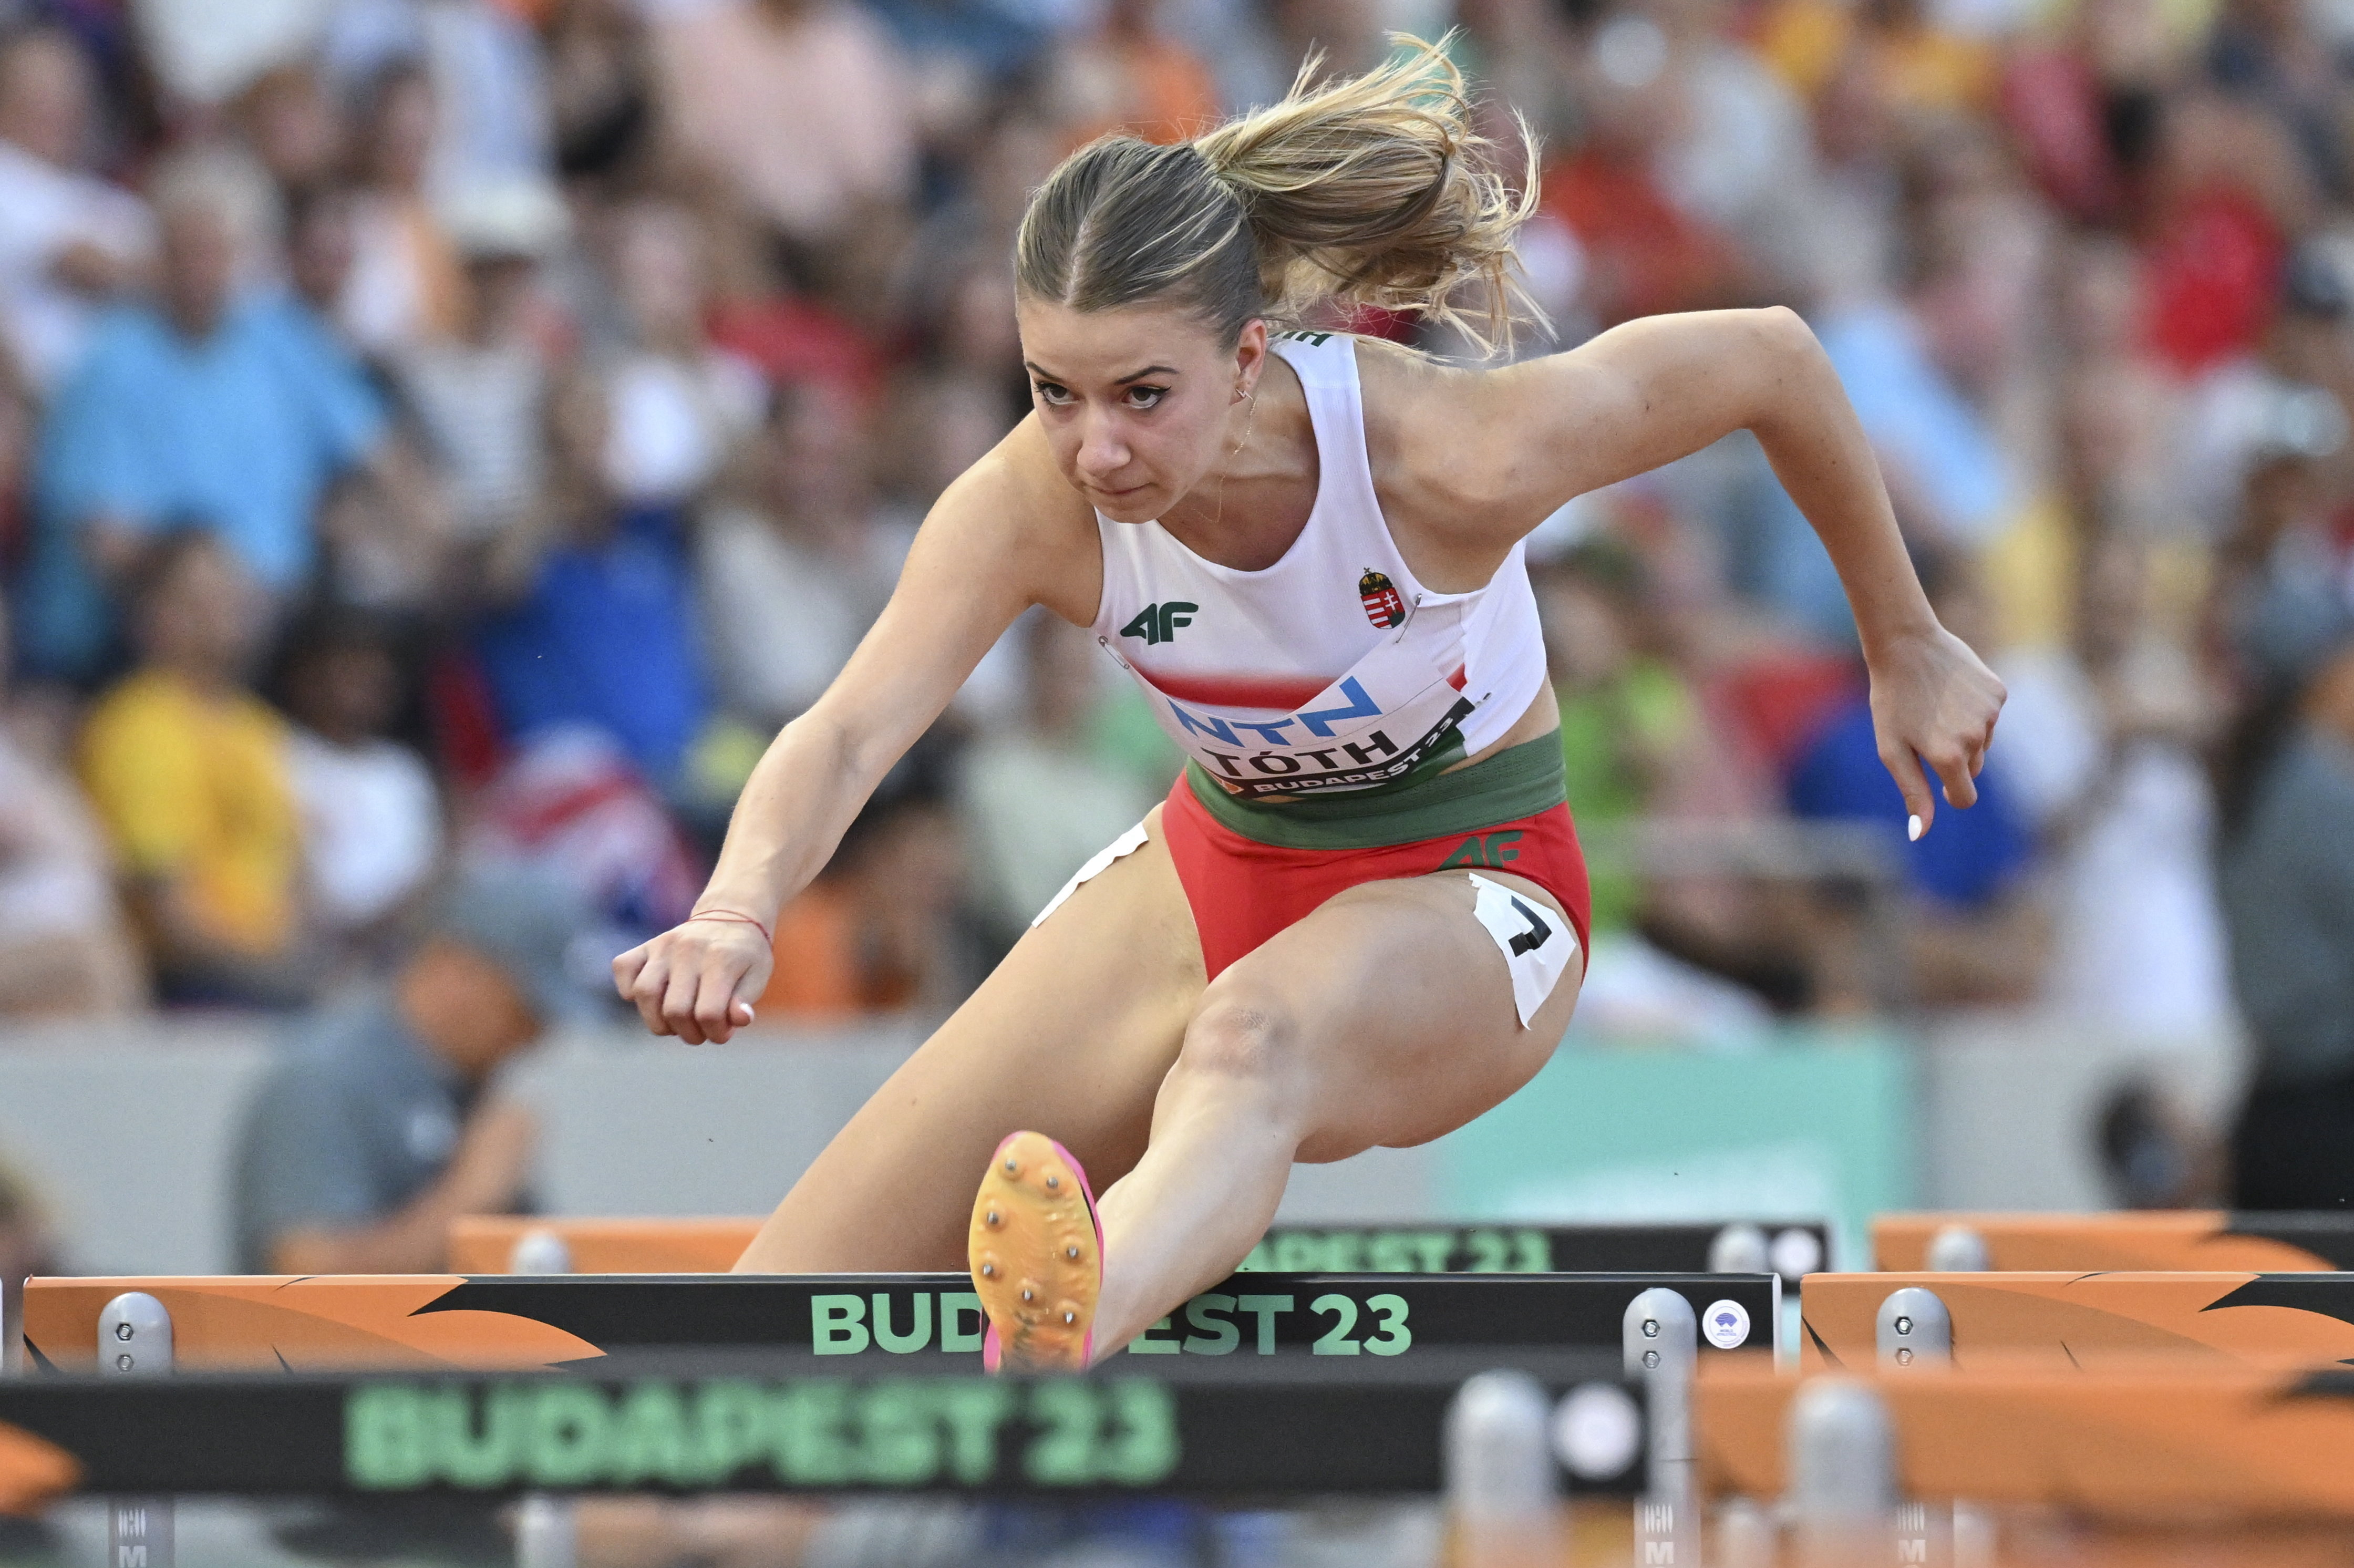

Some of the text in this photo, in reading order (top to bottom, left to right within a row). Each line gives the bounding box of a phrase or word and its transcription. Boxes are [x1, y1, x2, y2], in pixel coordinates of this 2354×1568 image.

[1200, 730, 1399, 777] TÓTH
[1254, 717, 1454, 793] BUDAPEST 23
[811, 1292, 1412, 1356] BUDEST 23
[344, 1378, 1180, 1490] BUDAPEST 23
